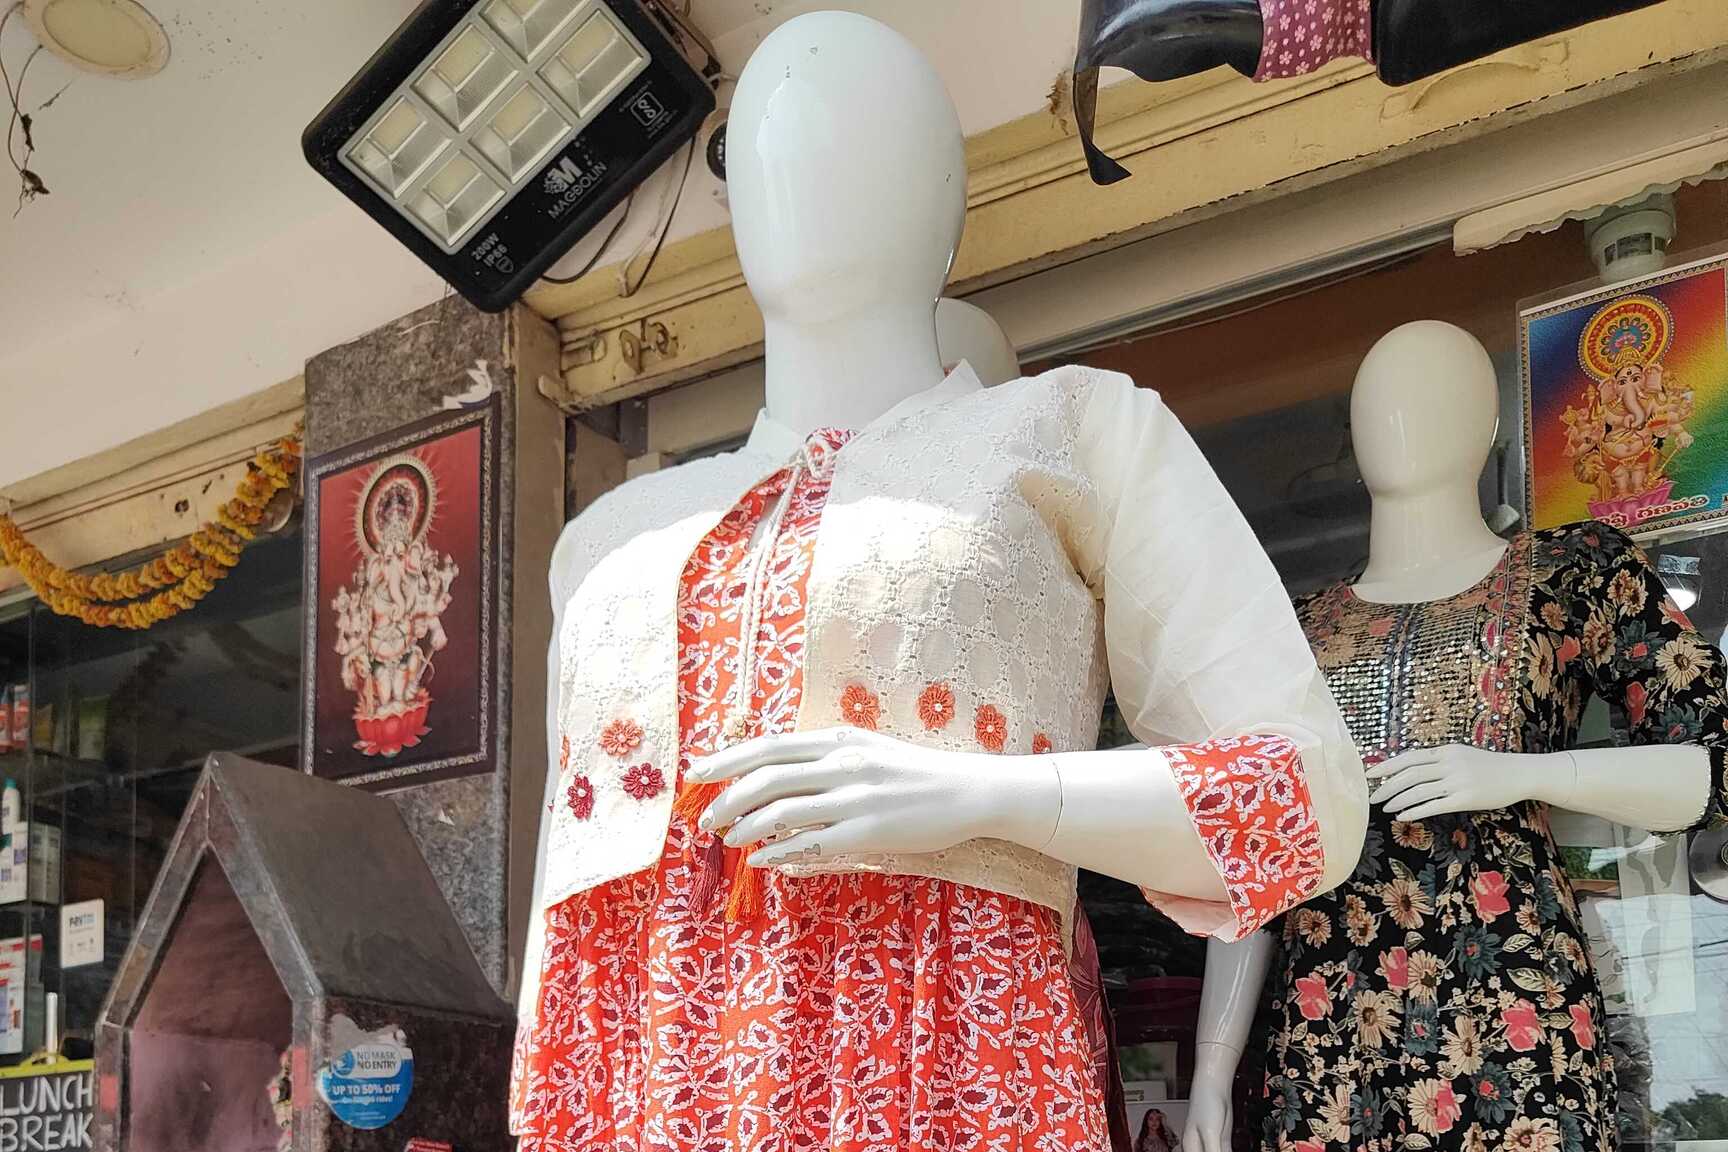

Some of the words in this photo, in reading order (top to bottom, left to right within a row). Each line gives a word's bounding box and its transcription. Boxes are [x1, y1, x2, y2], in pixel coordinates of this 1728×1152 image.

[547, 161, 607, 219] MAGDOLIN
[471, 232, 499, 260] 200W
[357, 1052, 370, 1060] NO
[371, 1051, 396, 1060] MASK
[357, 1061, 371, 1070] NO
[372, 1061, 397, 1070] ENTRY
[0, 1073, 94, 1116] LUNCH
[332, 1085, 346, 1095] UP
[347, 1085, 360, 1095] TO
[361, 1084, 383, 1095] 50%
[384, 1084, 401, 1094] OFF
